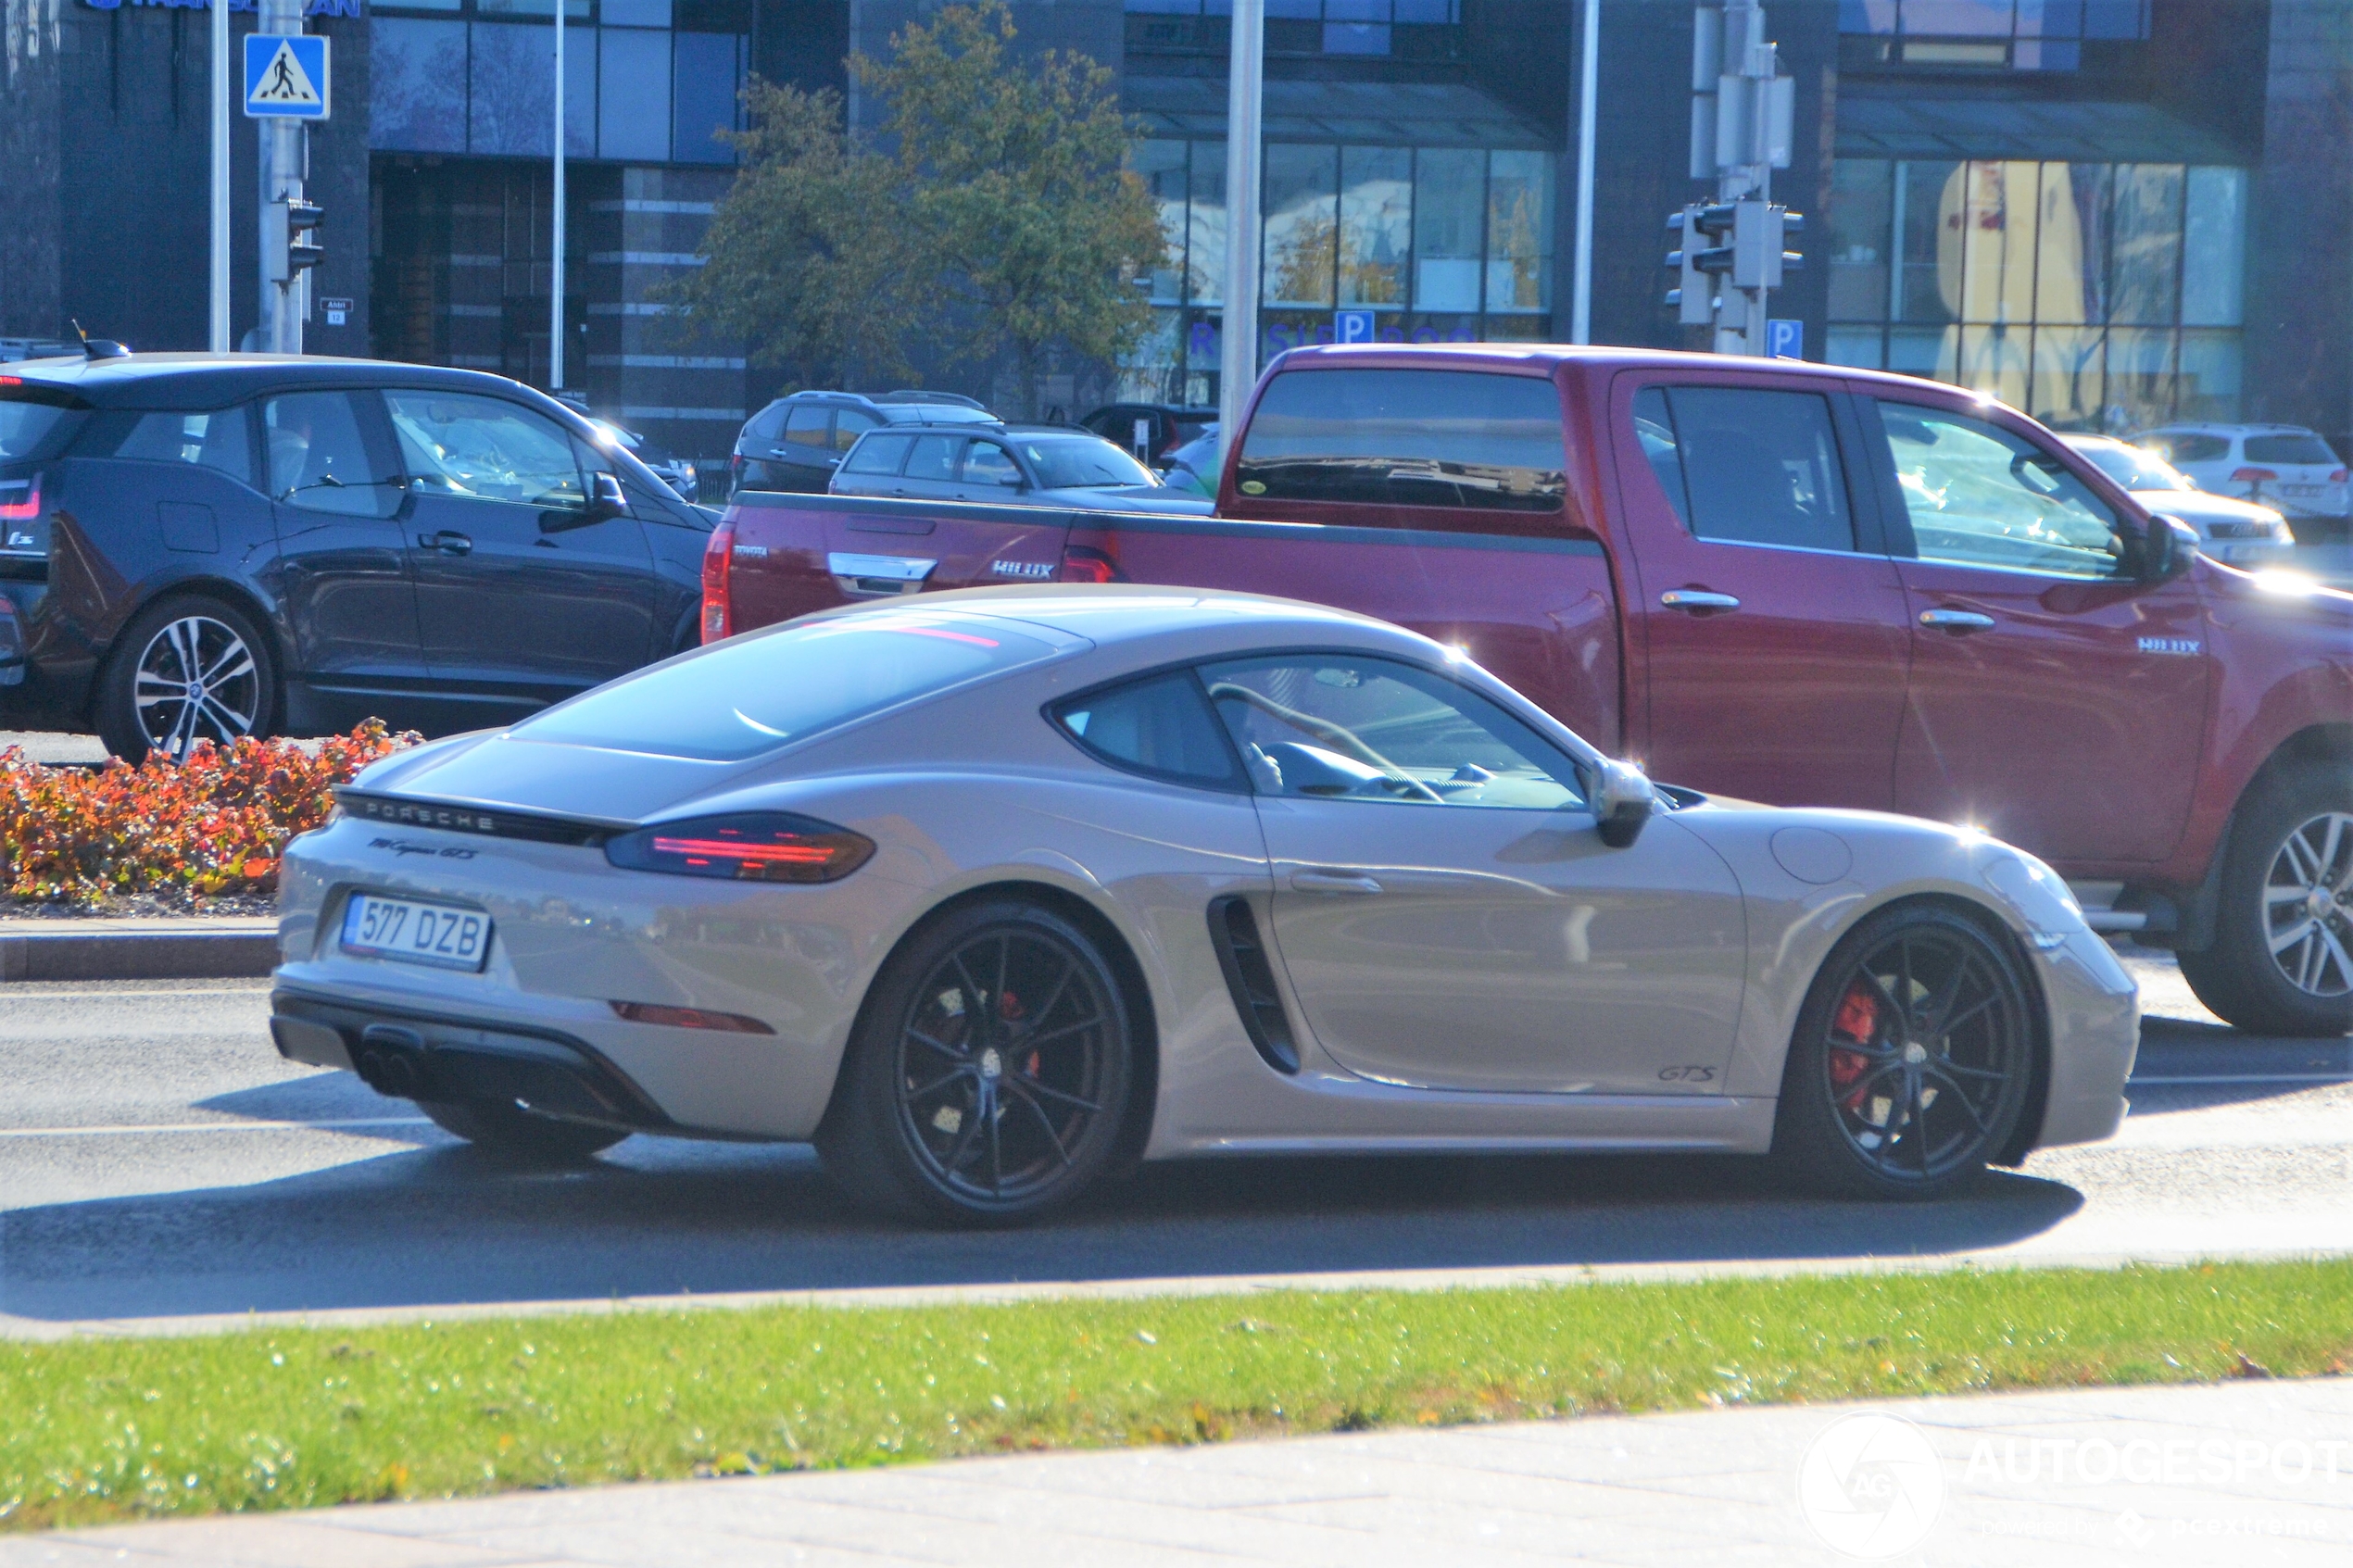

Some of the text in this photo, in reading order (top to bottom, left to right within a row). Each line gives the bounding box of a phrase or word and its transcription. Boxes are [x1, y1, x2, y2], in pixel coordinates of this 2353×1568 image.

[1345, 314, 1365, 345] P
[1775, 323, 1793, 354] P
[992, 559, 1054, 579] HILUX
[2137, 636, 2200, 656] HILUX
[367, 803, 493, 829] PORSCHE
[362, 902, 479, 956] 577 DZB
[1657, 1065, 1718, 1083] GTS
